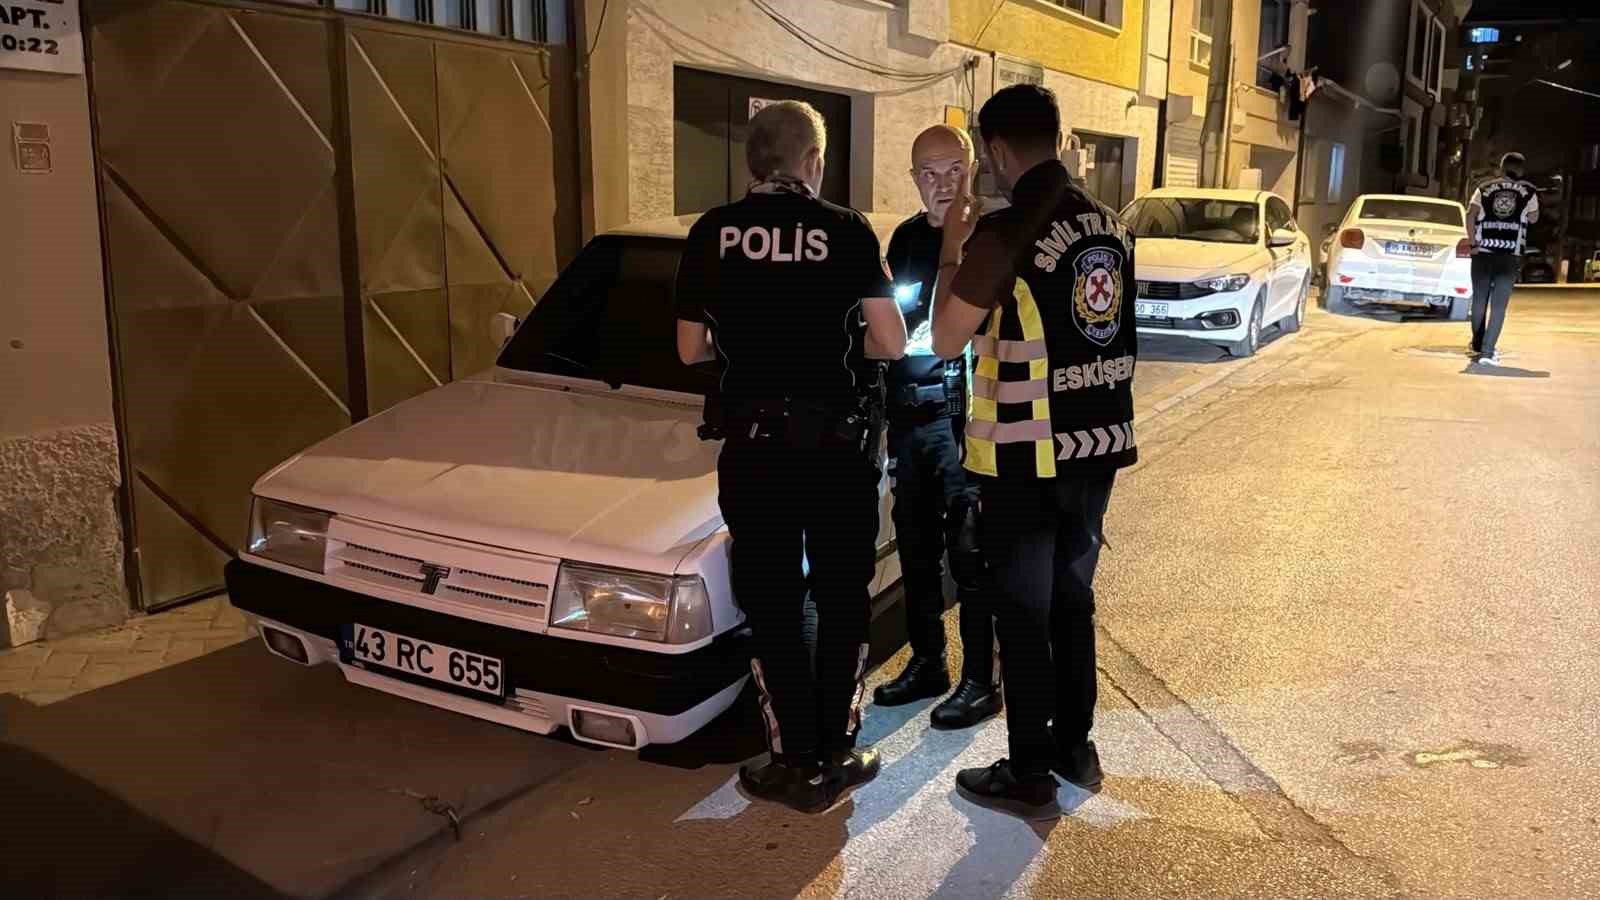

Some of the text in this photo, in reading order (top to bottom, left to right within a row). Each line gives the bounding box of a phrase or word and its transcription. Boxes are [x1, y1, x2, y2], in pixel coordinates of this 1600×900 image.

[720, 222, 829, 262] POLİS
[356, 628, 386, 662] 43
[397, 638, 434, 674] RC
[449, 651, 499, 691] 655
